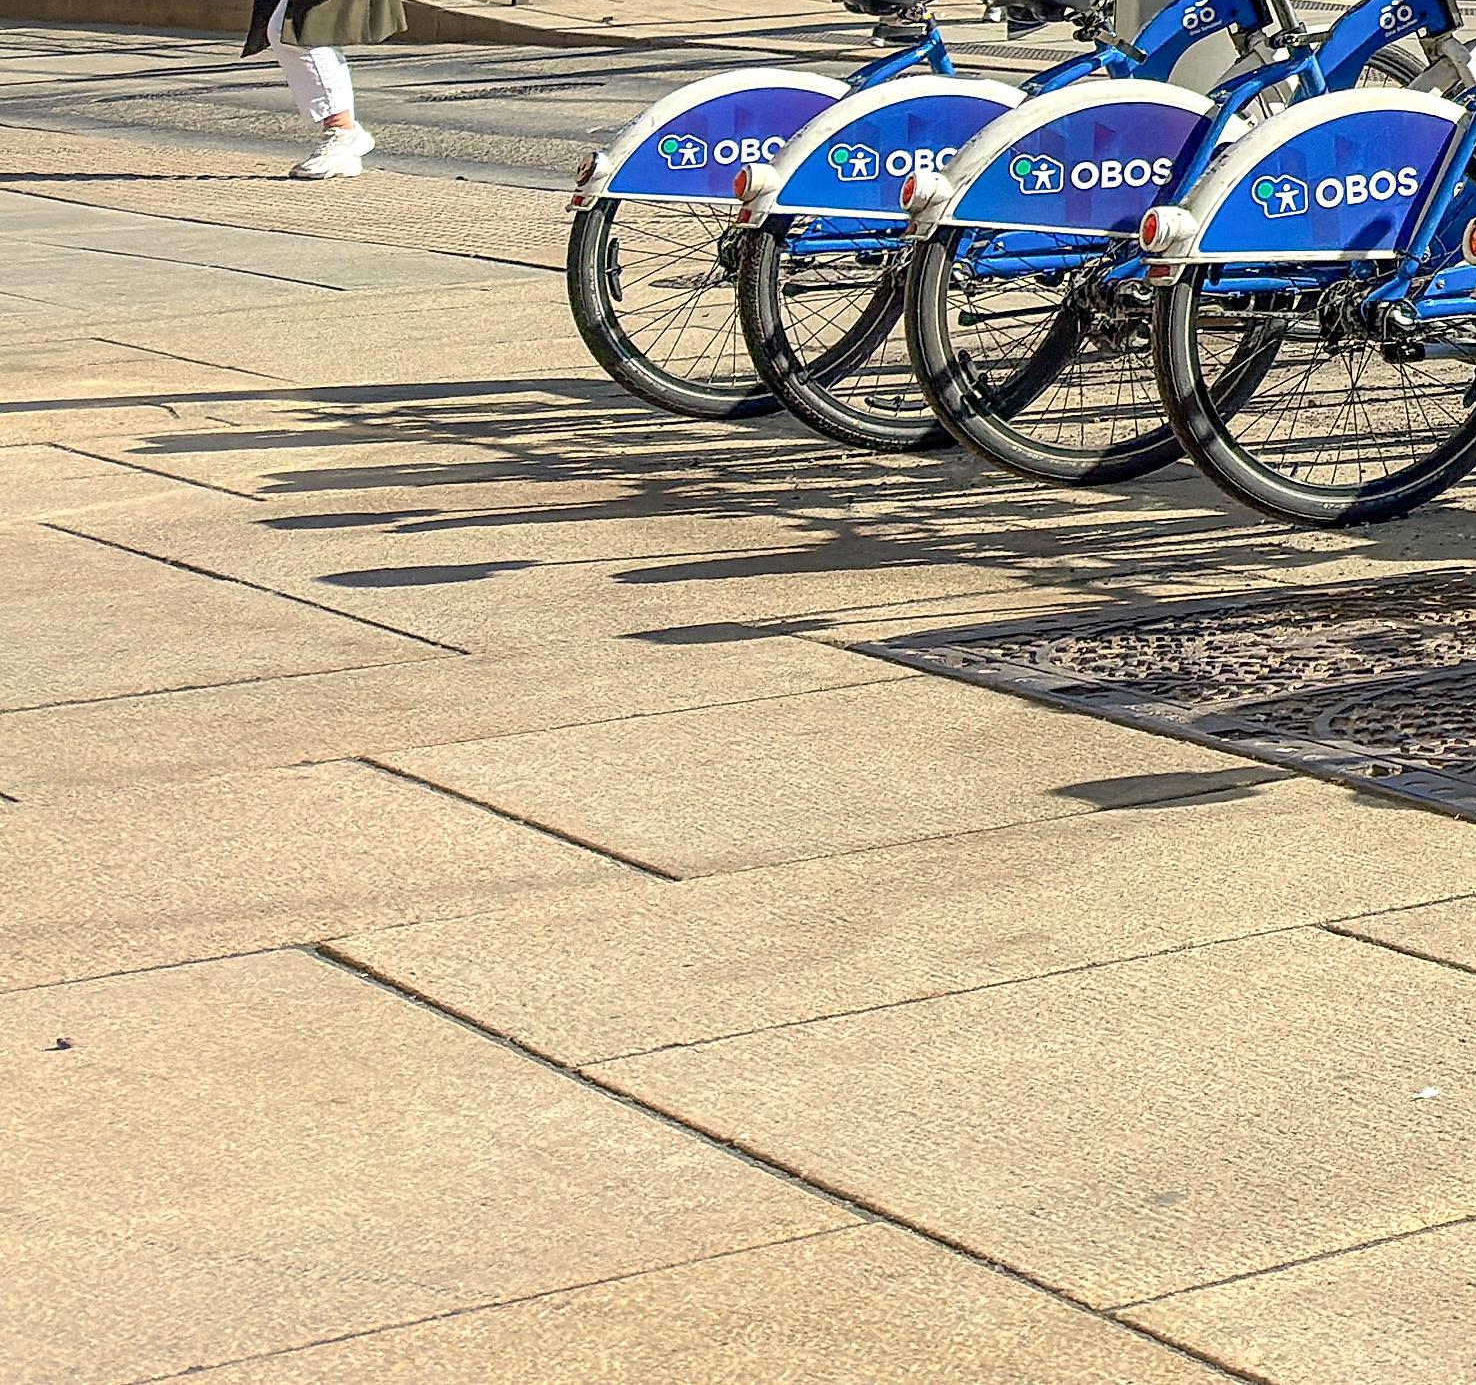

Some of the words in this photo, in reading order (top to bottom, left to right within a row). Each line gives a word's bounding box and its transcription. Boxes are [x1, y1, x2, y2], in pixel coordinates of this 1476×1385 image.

[713, 136, 786, 165] OBO
[1071, 157, 1174, 190] OBOS
[1314, 166, 1419, 209] OBOS
